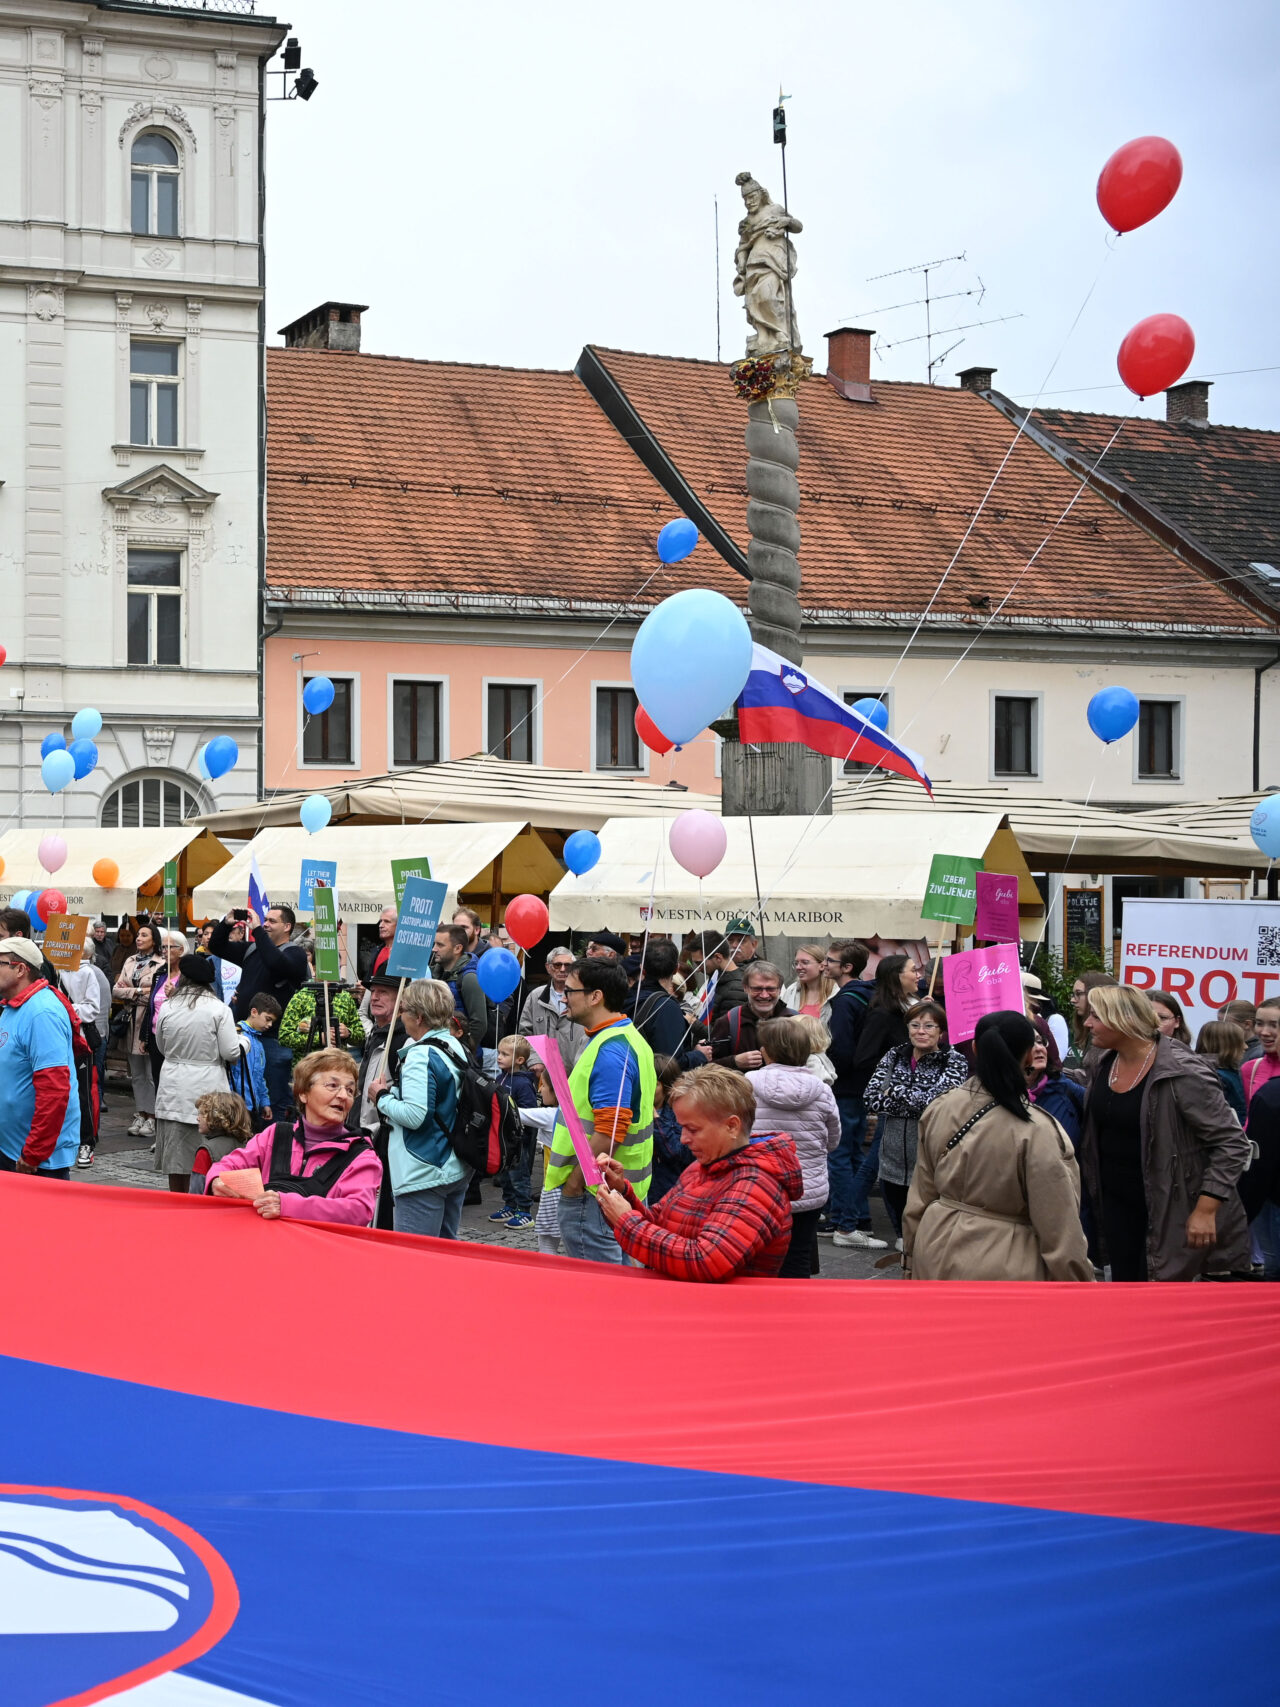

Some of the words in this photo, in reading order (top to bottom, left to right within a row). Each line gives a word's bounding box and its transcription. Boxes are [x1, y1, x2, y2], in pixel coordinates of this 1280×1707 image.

[942, 874, 967, 885] IZBERI
[928, 882, 977, 899] ŽIVLJENJE!
[66, 896, 84, 905] IBOR
[338, 903, 383, 913] MARIBOR
[409, 896, 434, 916] PROTI
[657, 909, 712, 921] MESTNA
[716, 908, 770, 922] OBČINA
[774, 911, 844, 923] MARIBOR
[396, 930, 433, 948] OSTARELIH
[1125, 943, 1249, 962] REFERENDUM
[986, 977, 1002, 986] oba
